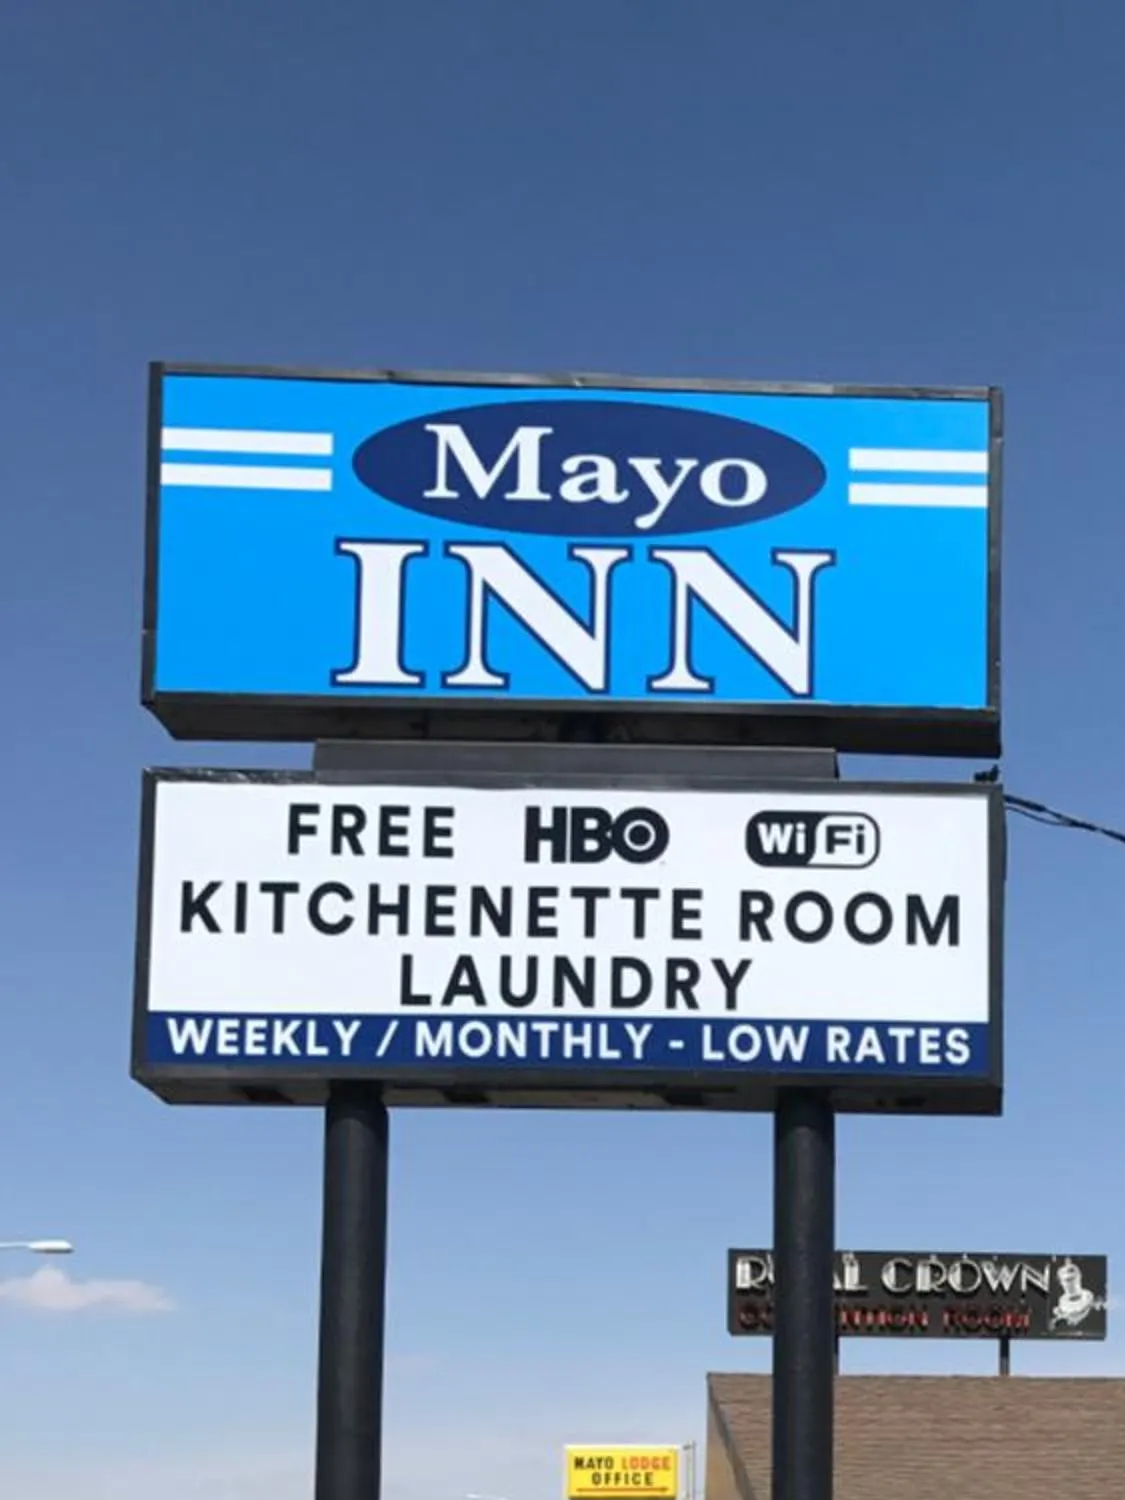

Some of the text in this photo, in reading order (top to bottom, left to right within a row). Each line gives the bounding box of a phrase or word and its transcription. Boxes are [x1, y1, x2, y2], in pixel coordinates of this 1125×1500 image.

[423, 424, 769, 530] Mayo
[334, 539, 834, 695] INN
[286, 802, 456, 859] FREE
[523, 804, 671, 865] HBO
[179, 879, 961, 948] KITCHENETTE ROOM
[399, 953, 753, 1012] LAUNDRY
[166, 1017, 362, 1057] WEEKLY
[415, 1020, 653, 1060] MONTHLY
[702, 1024, 810, 1062] LOW
[826, 1025, 971, 1065] RATES
[881, 1255, 1053, 1294] CROWN
[574, 1456, 672, 1471] MAYO LODGE
[591, 1472, 654, 1486] OFFICE
